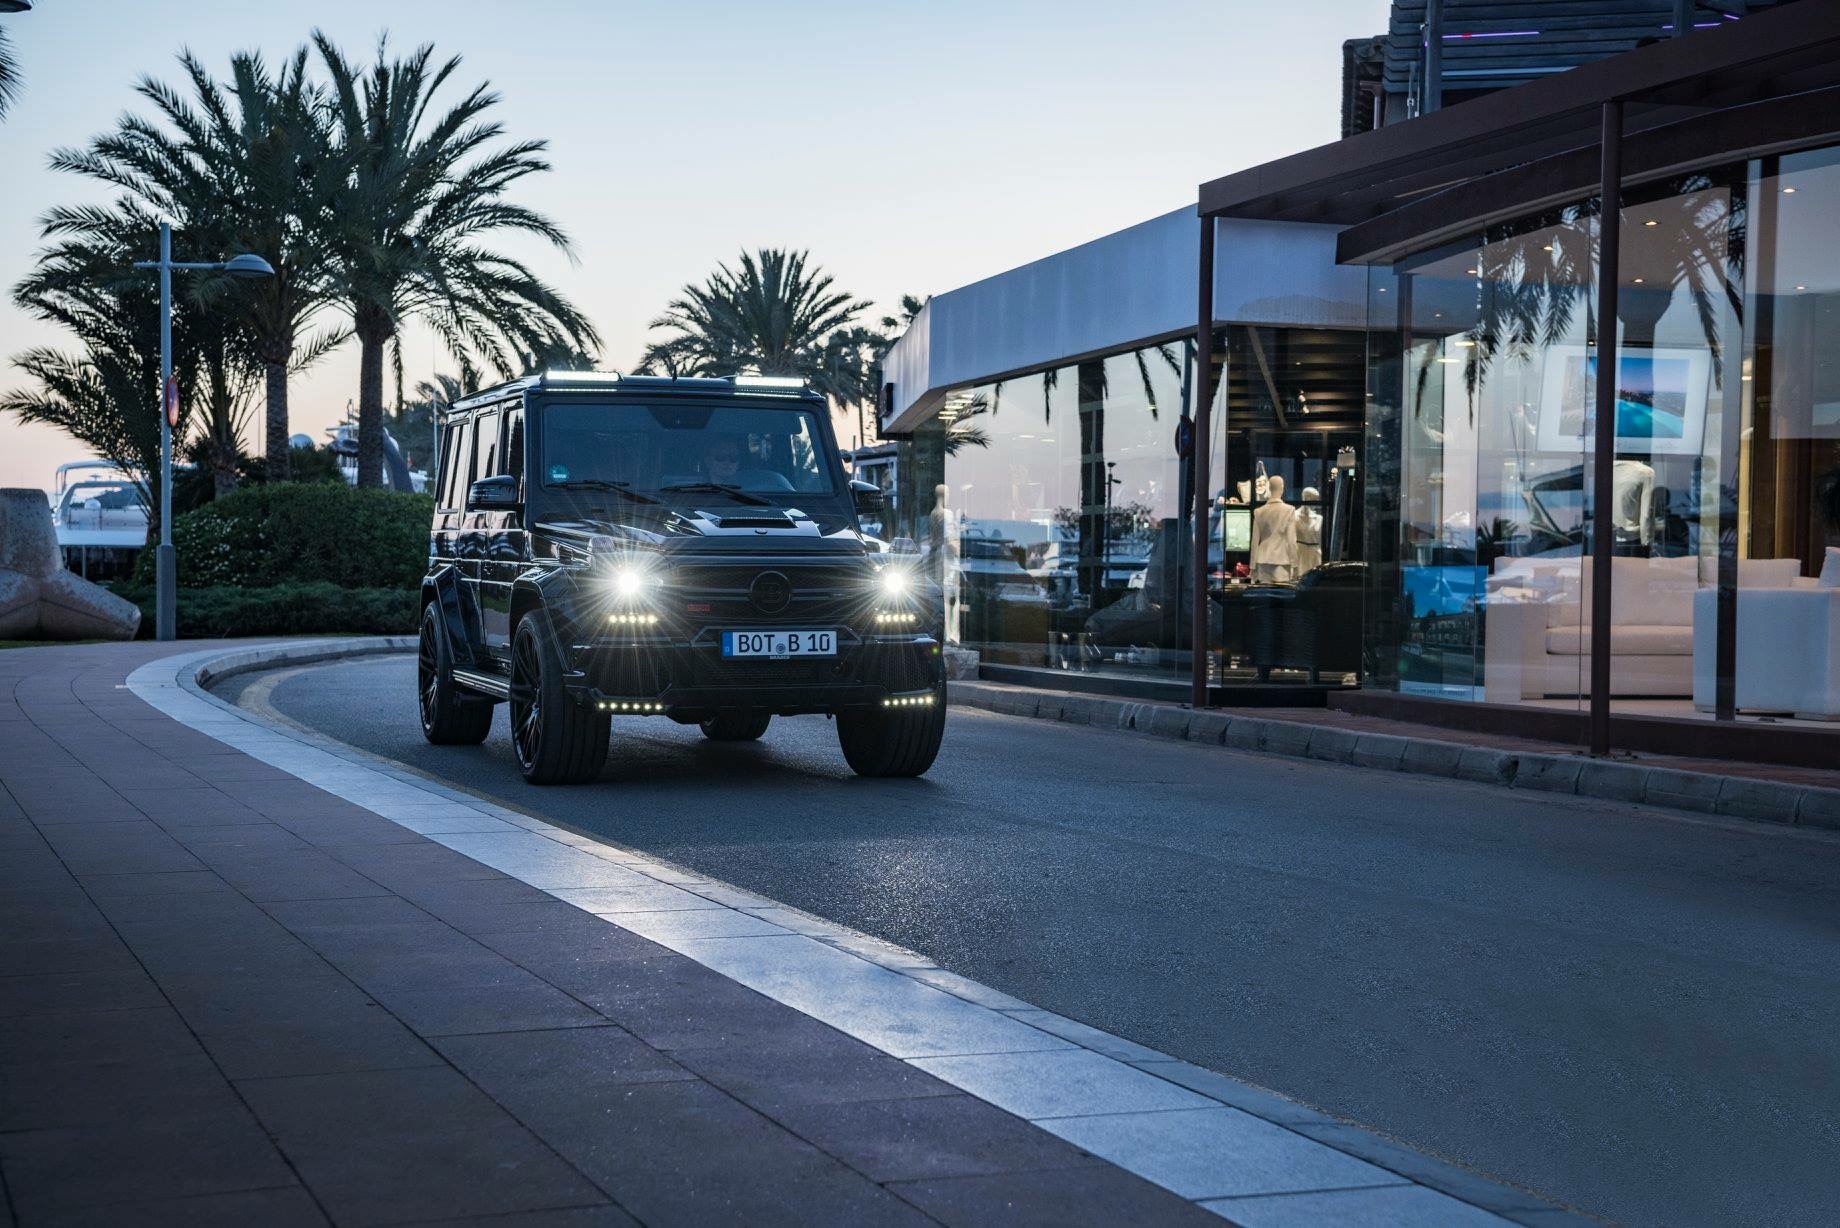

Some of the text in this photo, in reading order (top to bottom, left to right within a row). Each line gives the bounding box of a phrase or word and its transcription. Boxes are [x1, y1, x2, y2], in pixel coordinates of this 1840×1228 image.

[738, 633, 830, 653] BOT B 10
